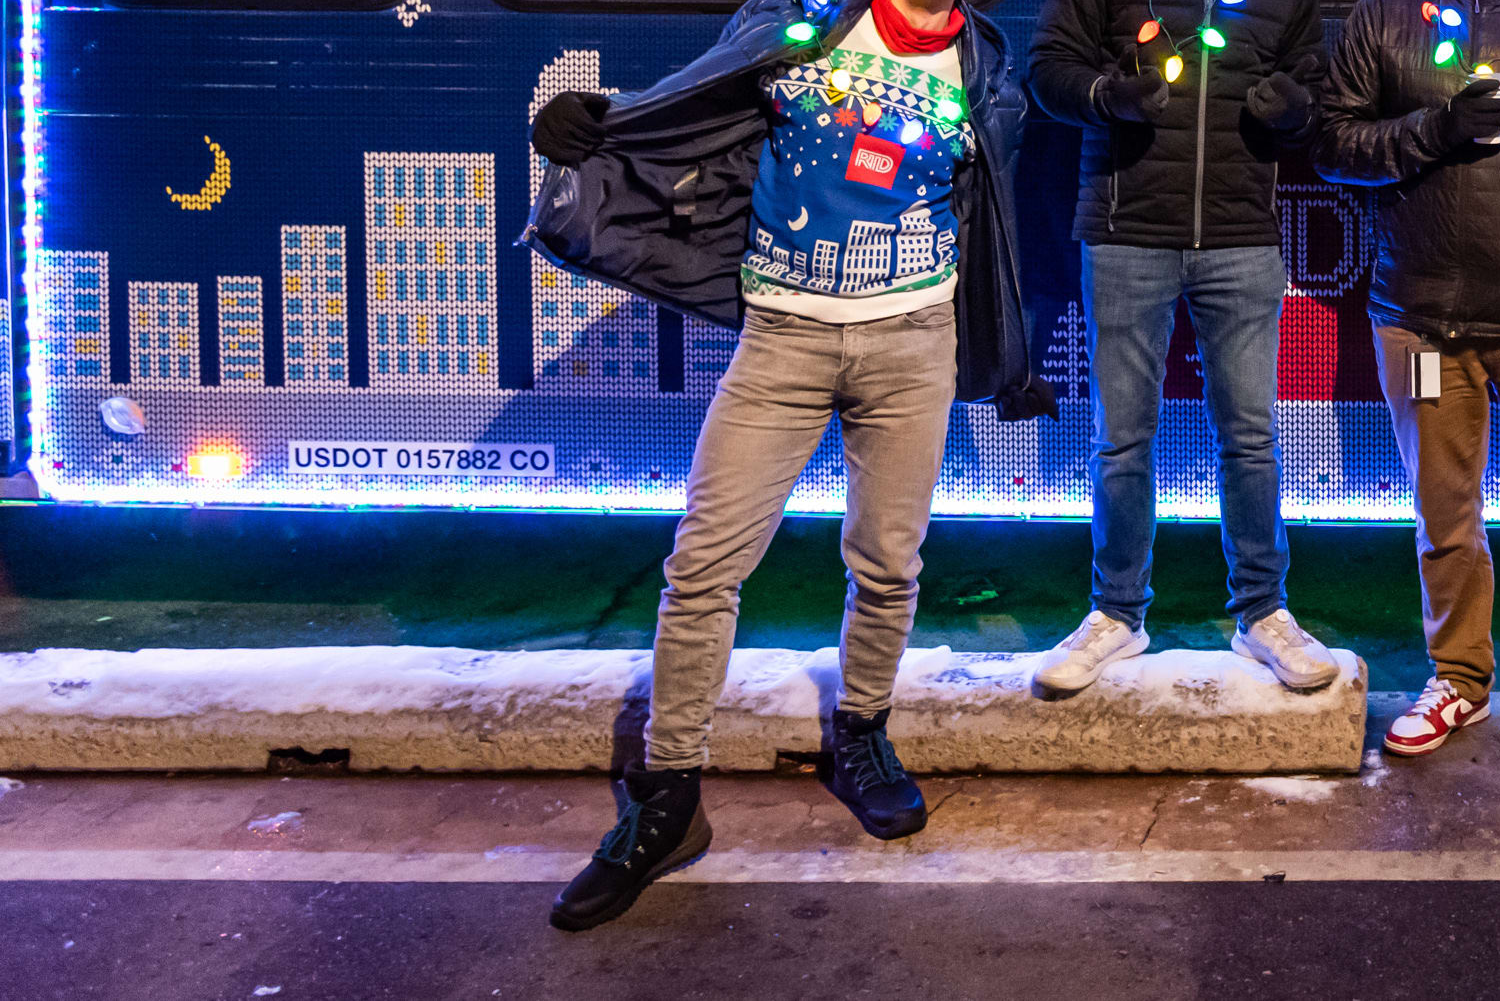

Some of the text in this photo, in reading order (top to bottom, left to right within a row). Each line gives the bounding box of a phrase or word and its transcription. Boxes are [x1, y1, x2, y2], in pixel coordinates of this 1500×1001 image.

[854, 148, 894, 174] RTD
[295, 447, 550, 471] USDOT 0157882 CO
